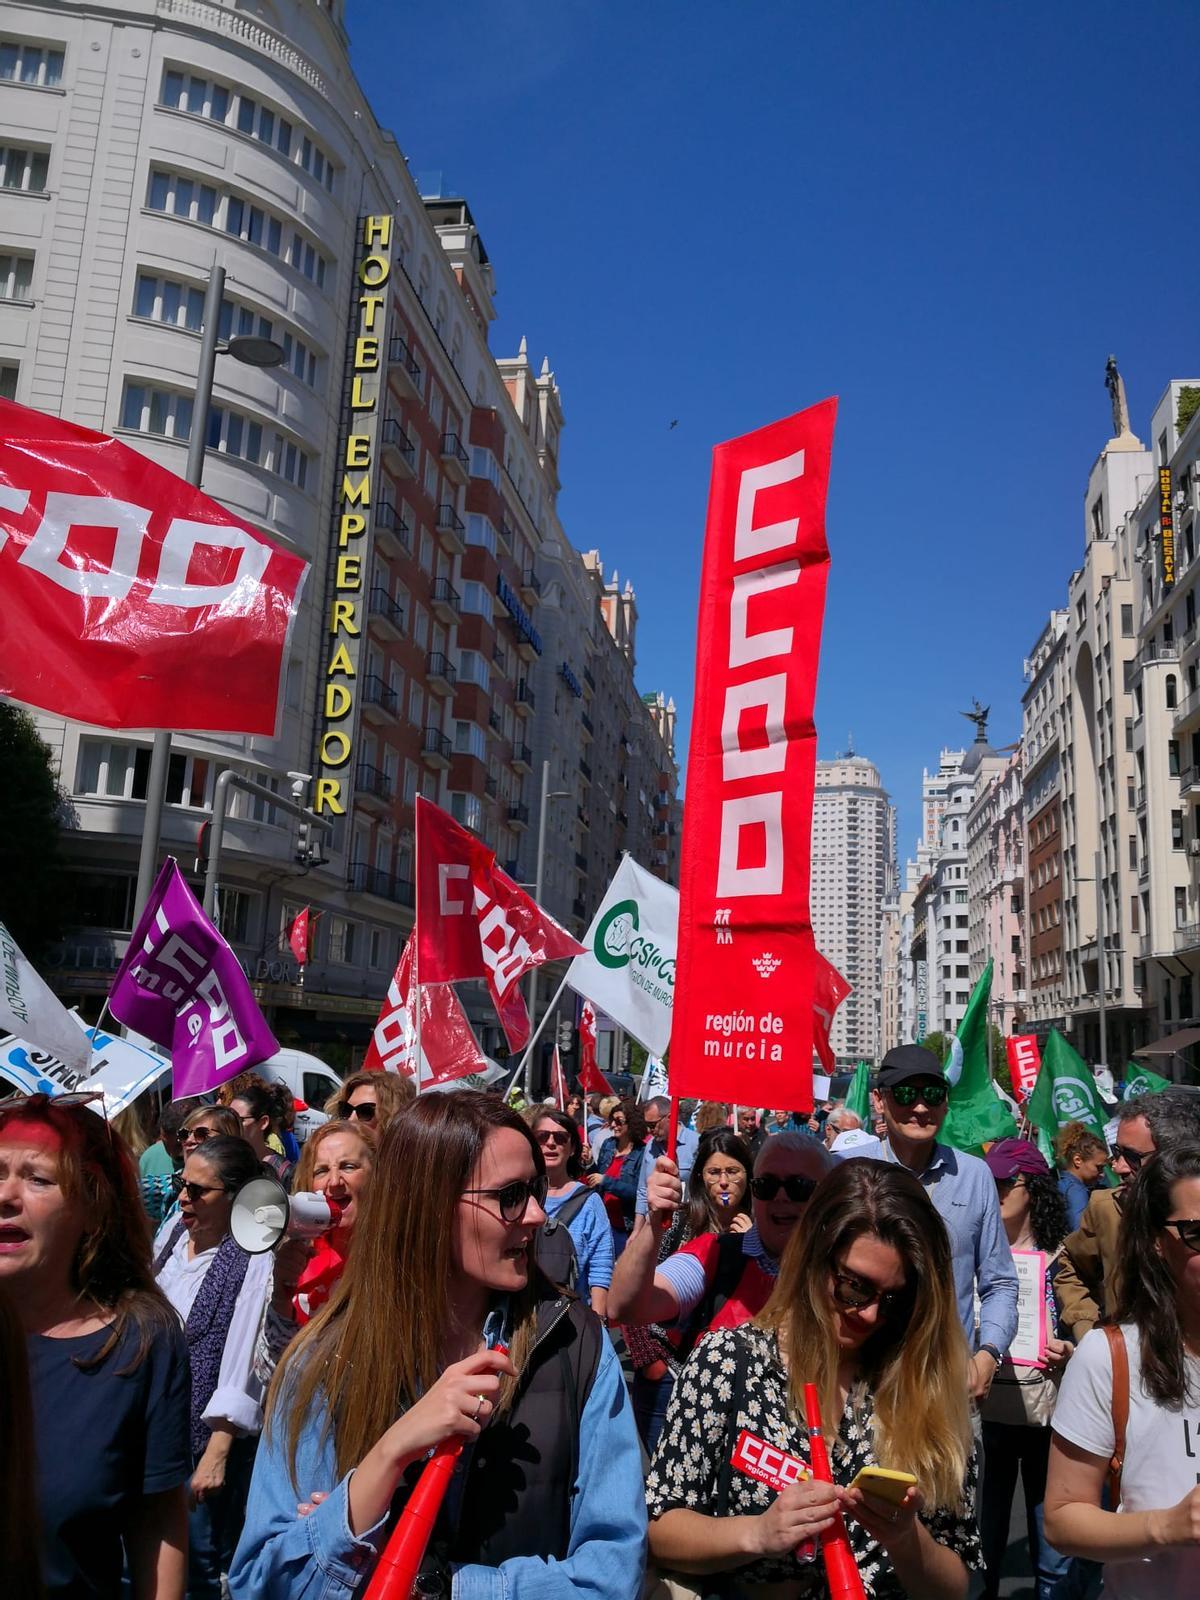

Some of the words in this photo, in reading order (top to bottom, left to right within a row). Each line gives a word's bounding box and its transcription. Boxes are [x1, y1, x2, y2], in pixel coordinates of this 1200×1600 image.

[352, 215, 391, 409] HOTEL
[1160, 469, 1172, 513] HOSTAL
[1162, 529, 1174, 582] BESAYA
[316, 434, 371, 814] EMPERADOR
[715, 448, 806, 899] CCOO
[705, 1009, 755, 1037] región
[759, 1012, 783, 1036] de
[703, 1040, 783, 1062] murcia
[744, 1462, 769, 1480] región
[769, 1476, 780, 1486] de
